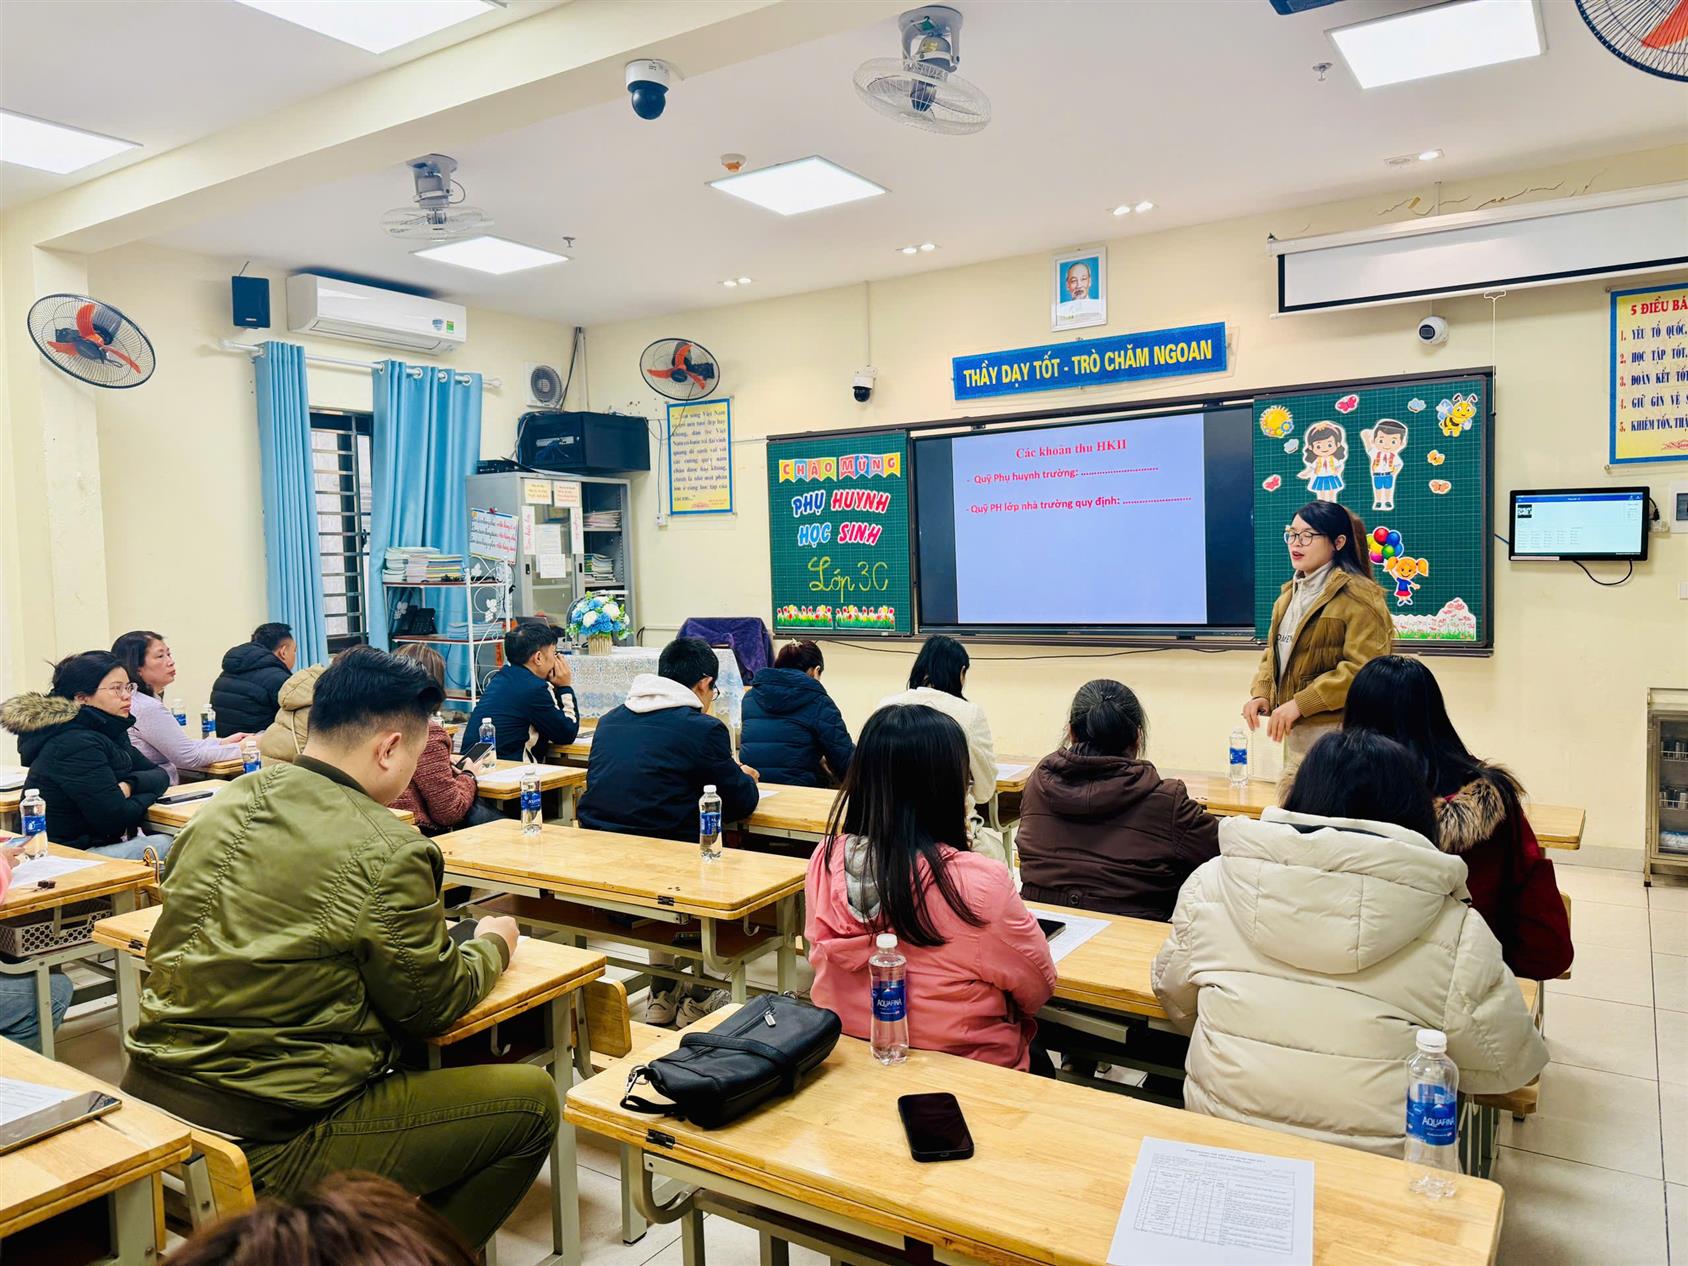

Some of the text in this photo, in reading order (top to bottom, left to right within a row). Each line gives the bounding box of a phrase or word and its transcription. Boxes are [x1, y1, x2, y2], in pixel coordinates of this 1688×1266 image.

[1630, 304, 1637, 315] 5
[1641, 296, 1669, 314] ĐIỀU
[1652, 321, 1661, 338] TỔ
[964, 360, 998, 387] THẦY
[1002, 362, 1030, 388] DẠY
[1034, 352, 1060, 380] TỐT
[1072, 349, 1100, 374] TRÒ
[1105, 344, 1149, 370] CHĂM
[1154, 340, 1212, 366] NGOAN
[1632, 352, 1646, 366] HỌC
[1652, 347, 1666, 364] TẬP
[1656, 366, 1670, 384] KẾT
[1016, 447, 1036, 459] Các
[1075, 442, 1093, 454] thu
[1097, 439, 1127, 452] HKII
[783, 456, 895, 476] CHÀO MỪNG
[974, 474, 992, 485] Quỹ
[994, 472, 1010, 484] Phụ
[1012, 470, 1040, 482] huynh
[1042, 469, 1079, 480] trường:
[793, 490, 890, 516] PHỤ HUYNH
[990, 502, 1002, 512] PH
[1004, 500, 1020, 513] lớp
[1040, 498, 1073, 510] trường
[1075, 500, 1093, 509] quy
[1095, 496, 1120, 508] định:
[798, 522, 882, 547] HỌC SINH
[808, 556, 888, 603] Lớp 3C
[876, 998, 902, 1008] AQUAFINA
[1422, 1116, 1455, 1128] AQUAFINA
